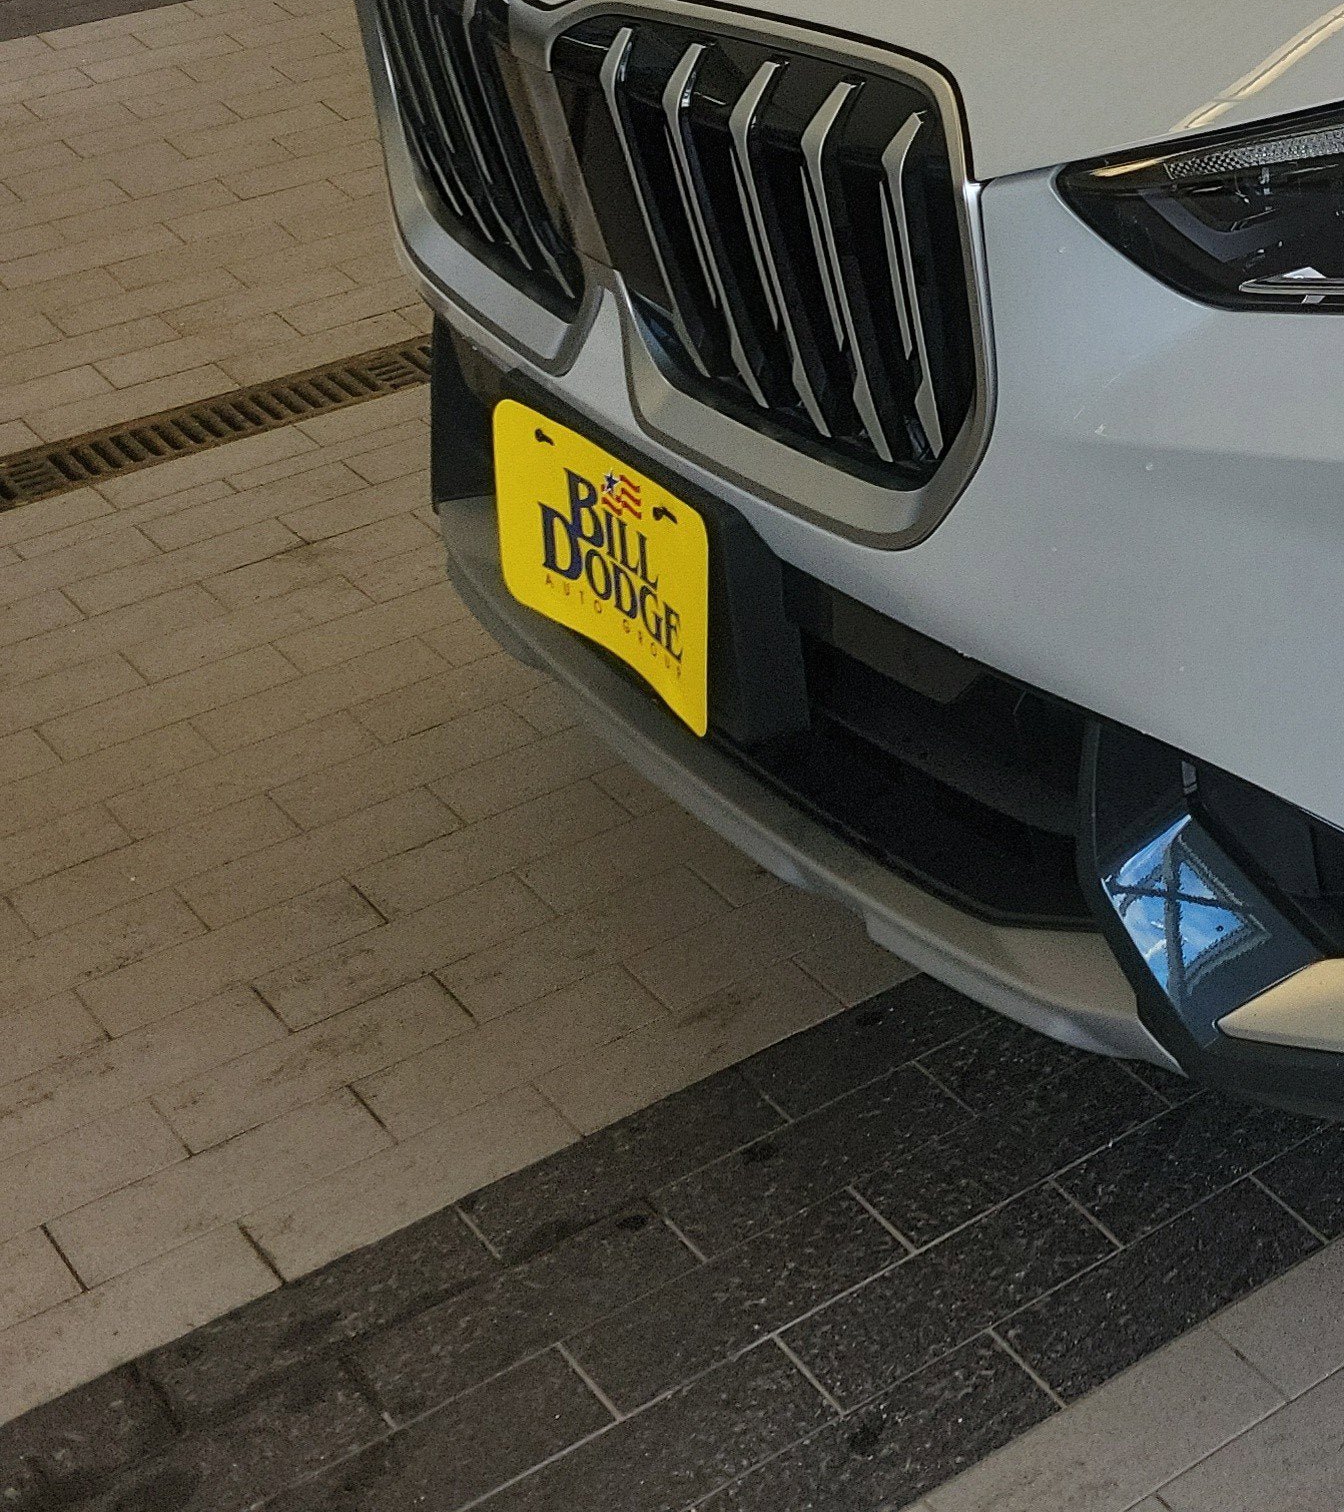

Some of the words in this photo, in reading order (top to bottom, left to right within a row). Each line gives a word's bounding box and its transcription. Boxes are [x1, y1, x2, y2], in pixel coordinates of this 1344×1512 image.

[537, 501, 683, 664] DODGE
[563, 466, 659, 588] BILL
[544, 573, 603, 615] AUTO
